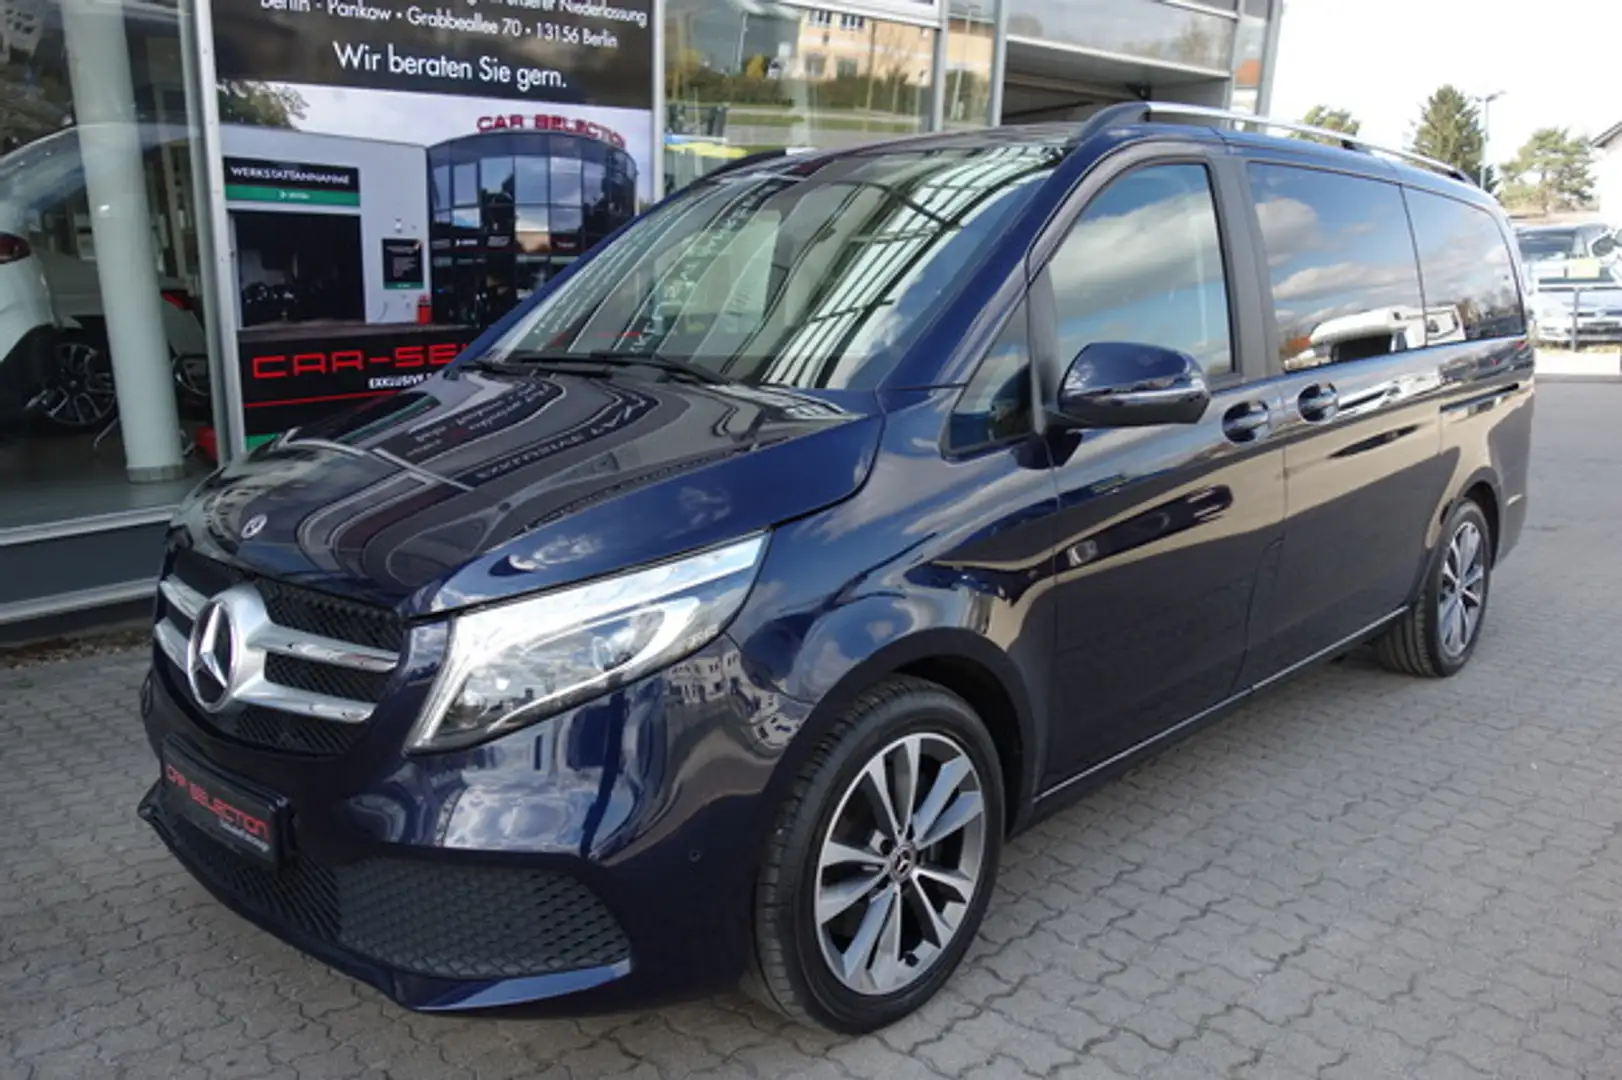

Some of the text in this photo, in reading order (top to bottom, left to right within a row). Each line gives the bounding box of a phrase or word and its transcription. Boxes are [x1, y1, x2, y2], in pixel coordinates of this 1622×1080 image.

[327, 0, 391, 21] Pankow
[407, 6, 498, 35] Grabbeallee
[502, 18, 522, 37] 70
[536, 22, 579, 44] 13156
[583, 28, 618, 48] Berlin
[332, 41, 567, 92] Wir beraten Sie gern.
[477, 114, 524, 133] CAR
[252, 344, 467, 378] CAR-SE
